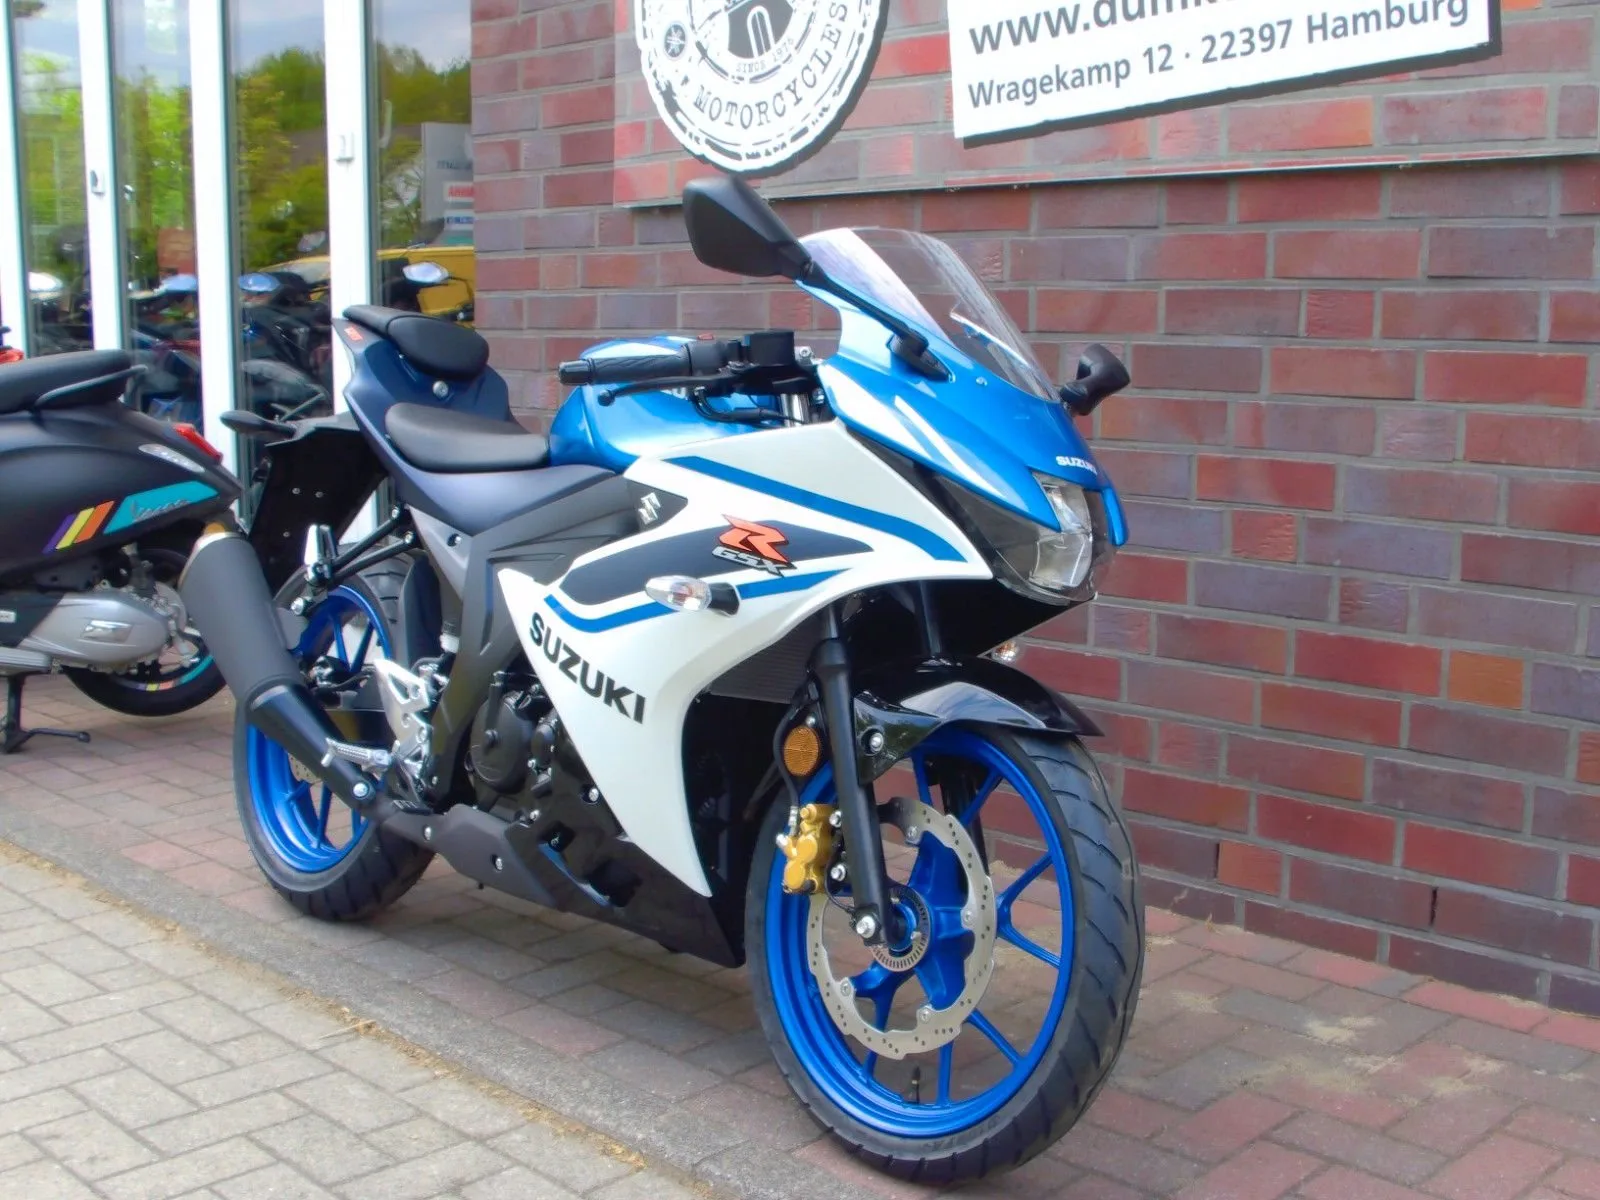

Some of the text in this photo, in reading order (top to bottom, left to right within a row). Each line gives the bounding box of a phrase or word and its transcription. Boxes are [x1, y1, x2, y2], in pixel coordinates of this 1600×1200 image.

[693, 2, 848, 130] MOTORCYCLES
[968, 0, 1469, 108] Wragekamp 12 22397 Hamburg
[529, 611, 646, 725] SUZUKI
